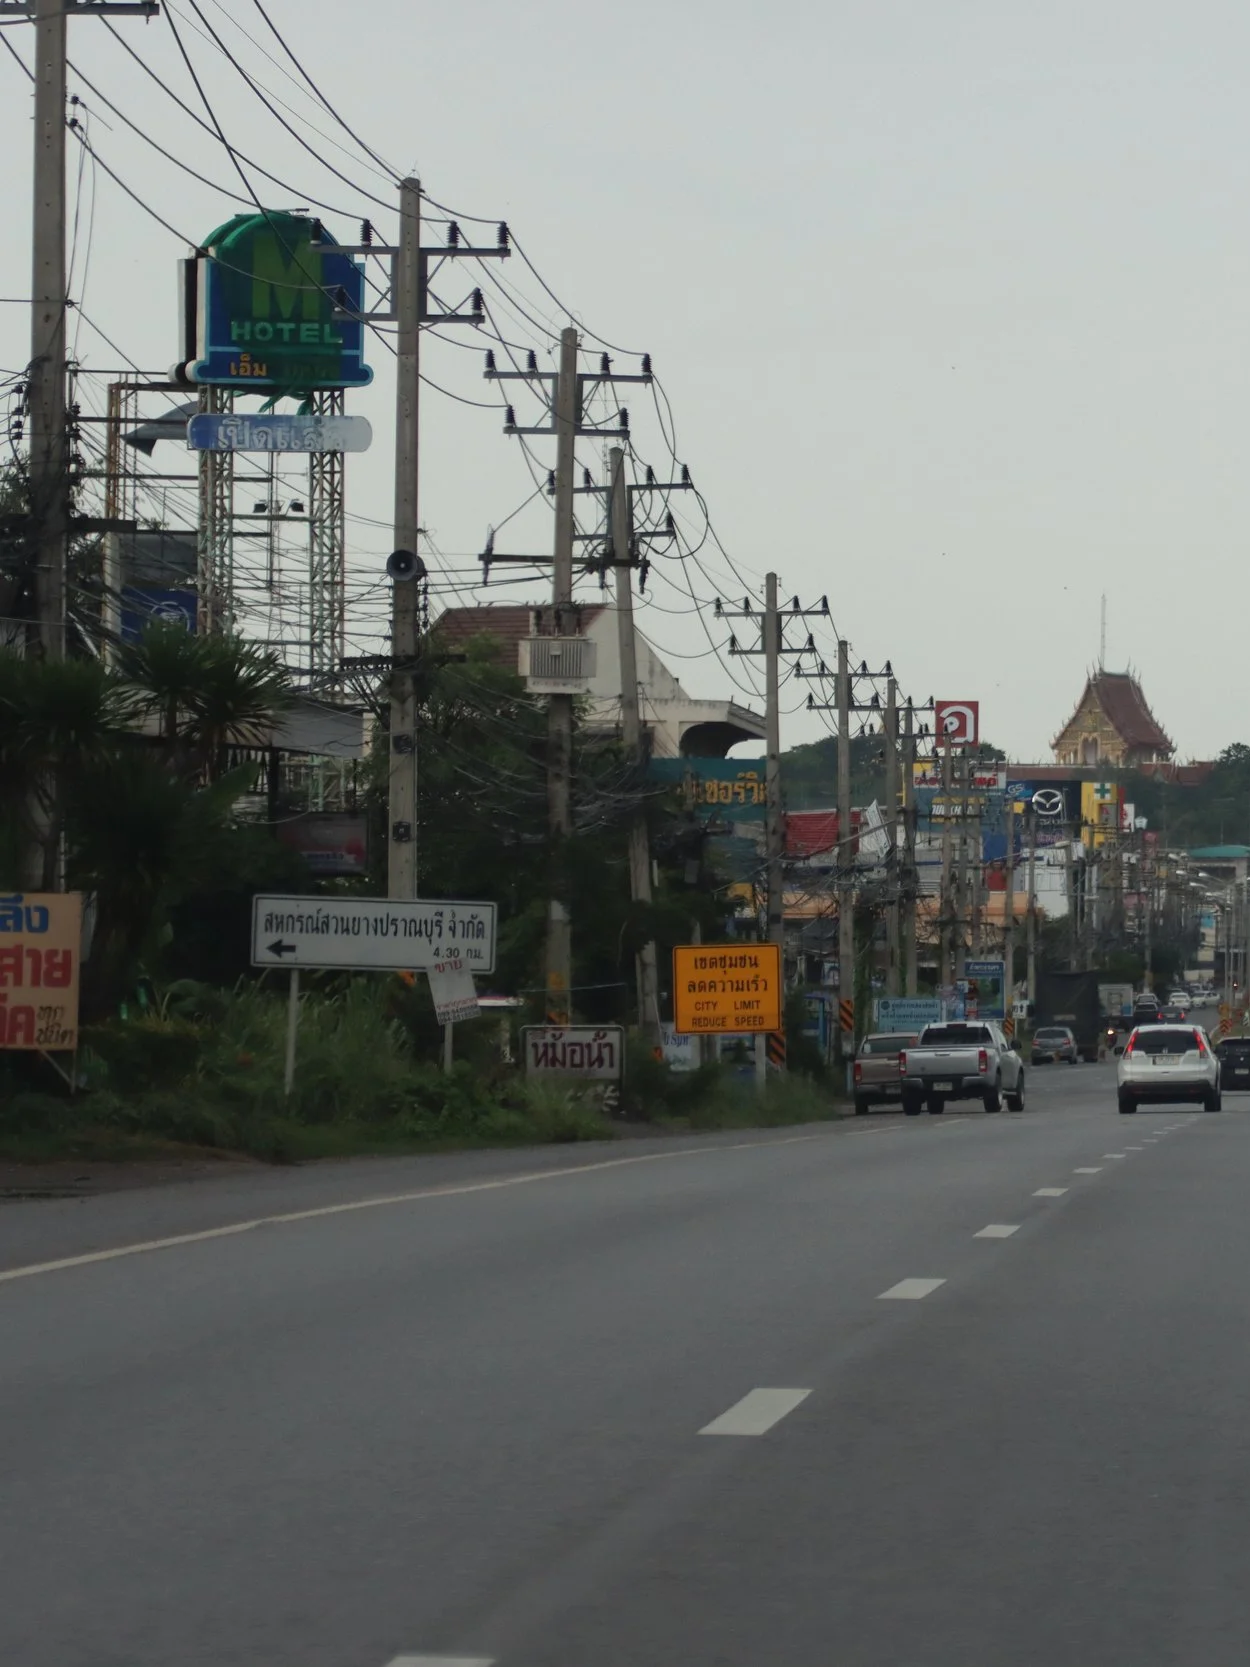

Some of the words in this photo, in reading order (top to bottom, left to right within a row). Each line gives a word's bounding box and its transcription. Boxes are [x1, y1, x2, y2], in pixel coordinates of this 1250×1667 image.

[253, 233, 323, 319] M
[231, 321, 343, 344] HOTEL
[264, 908, 445, 945] สหกรณ์สวนยางปราณบุรี
[448, 908, 486, 940] จำกัด
[433, 947, 460, 959] 4.30
[434, 959, 463, 973] ขาย
[693, 954, 760, 975] เขตชุมชน
[687, 974, 768, 993] ลดความเร็ว
[694, 1001, 718, 1011] CITY
[734, 1000, 761, 1011] LIMIT
[691, 1016, 727, 1028] REDUCE
[734, 1015, 765, 1026] SPEED
[531, 1030, 615, 1068] หม้อน้ำ
